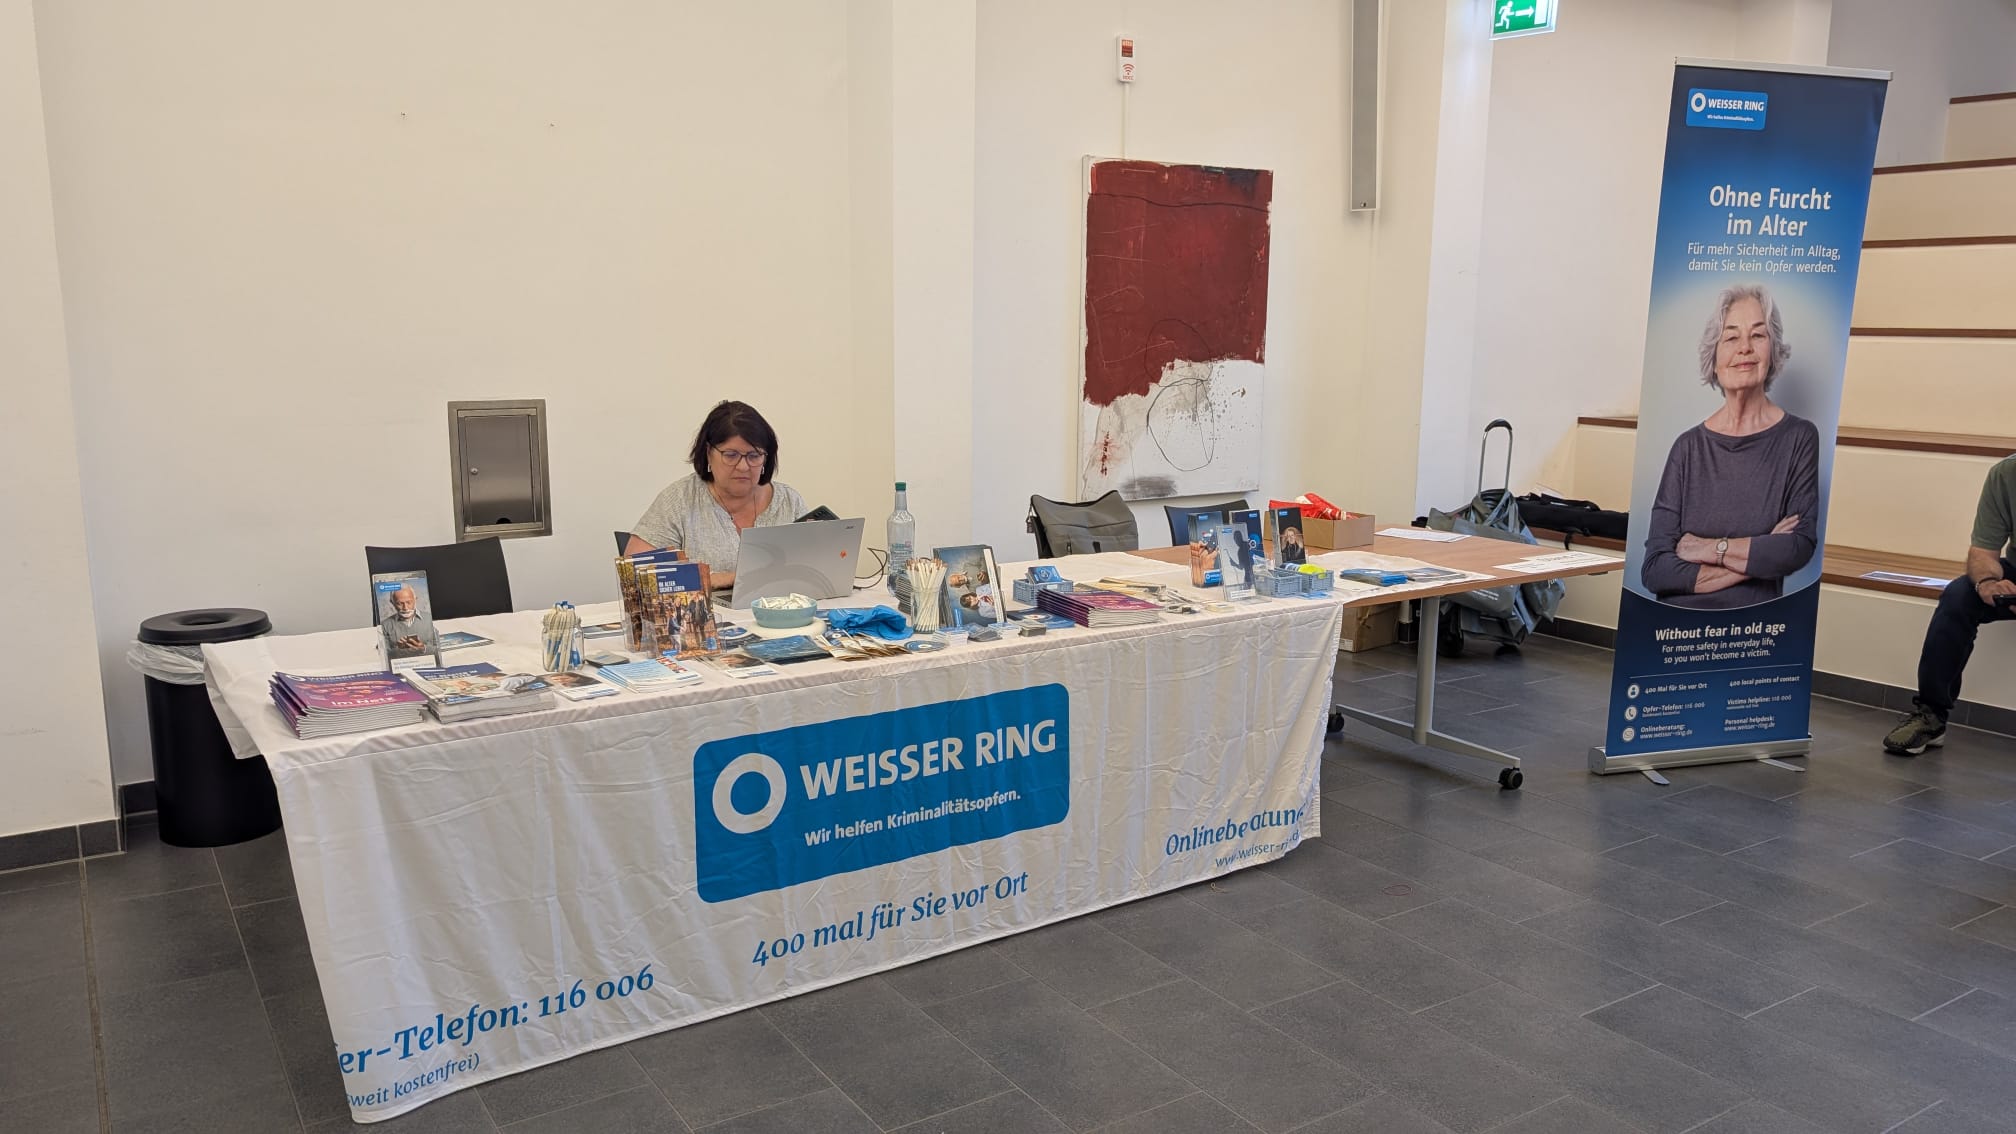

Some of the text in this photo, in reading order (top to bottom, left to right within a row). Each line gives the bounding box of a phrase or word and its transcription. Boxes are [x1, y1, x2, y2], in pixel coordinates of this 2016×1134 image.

[1708, 99, 1764, 112] WEISSER RING
[1709, 184, 1832, 210] Ohne Furcht
[1726, 213, 1808, 237] im Alter
[1687, 242, 1841, 260] Für mehr Sicherheit im Alltag,
[1688, 258, 1836, 275] damit Sie kein Opfer werden.
[1655, 622, 1786, 641] Without fear in old age
[1662, 637, 1776, 654] For more safety in everyday life,
[1674, 656, 1688, 665] you
[1689, 652, 1710, 662] won't
[1712, 651, 1740, 660] become
[1746, 648, 1771, 658] victim.
[1755, 678, 1772, 686] points
[800, 718, 1056, 801] WEISSER RING
[804, 788, 1022, 848] Wir helfen Kriminalitätsopfern.
[1166, 803, 1306, 856] Onlinebeatun
[752, 871, 1028, 968] 400 mal für Sie vor Ort
[538, 978, 586, 1018] 116
[595, 964, 654, 1000] 006
[347, 1052, 480, 1106] weit kostenfrei)
